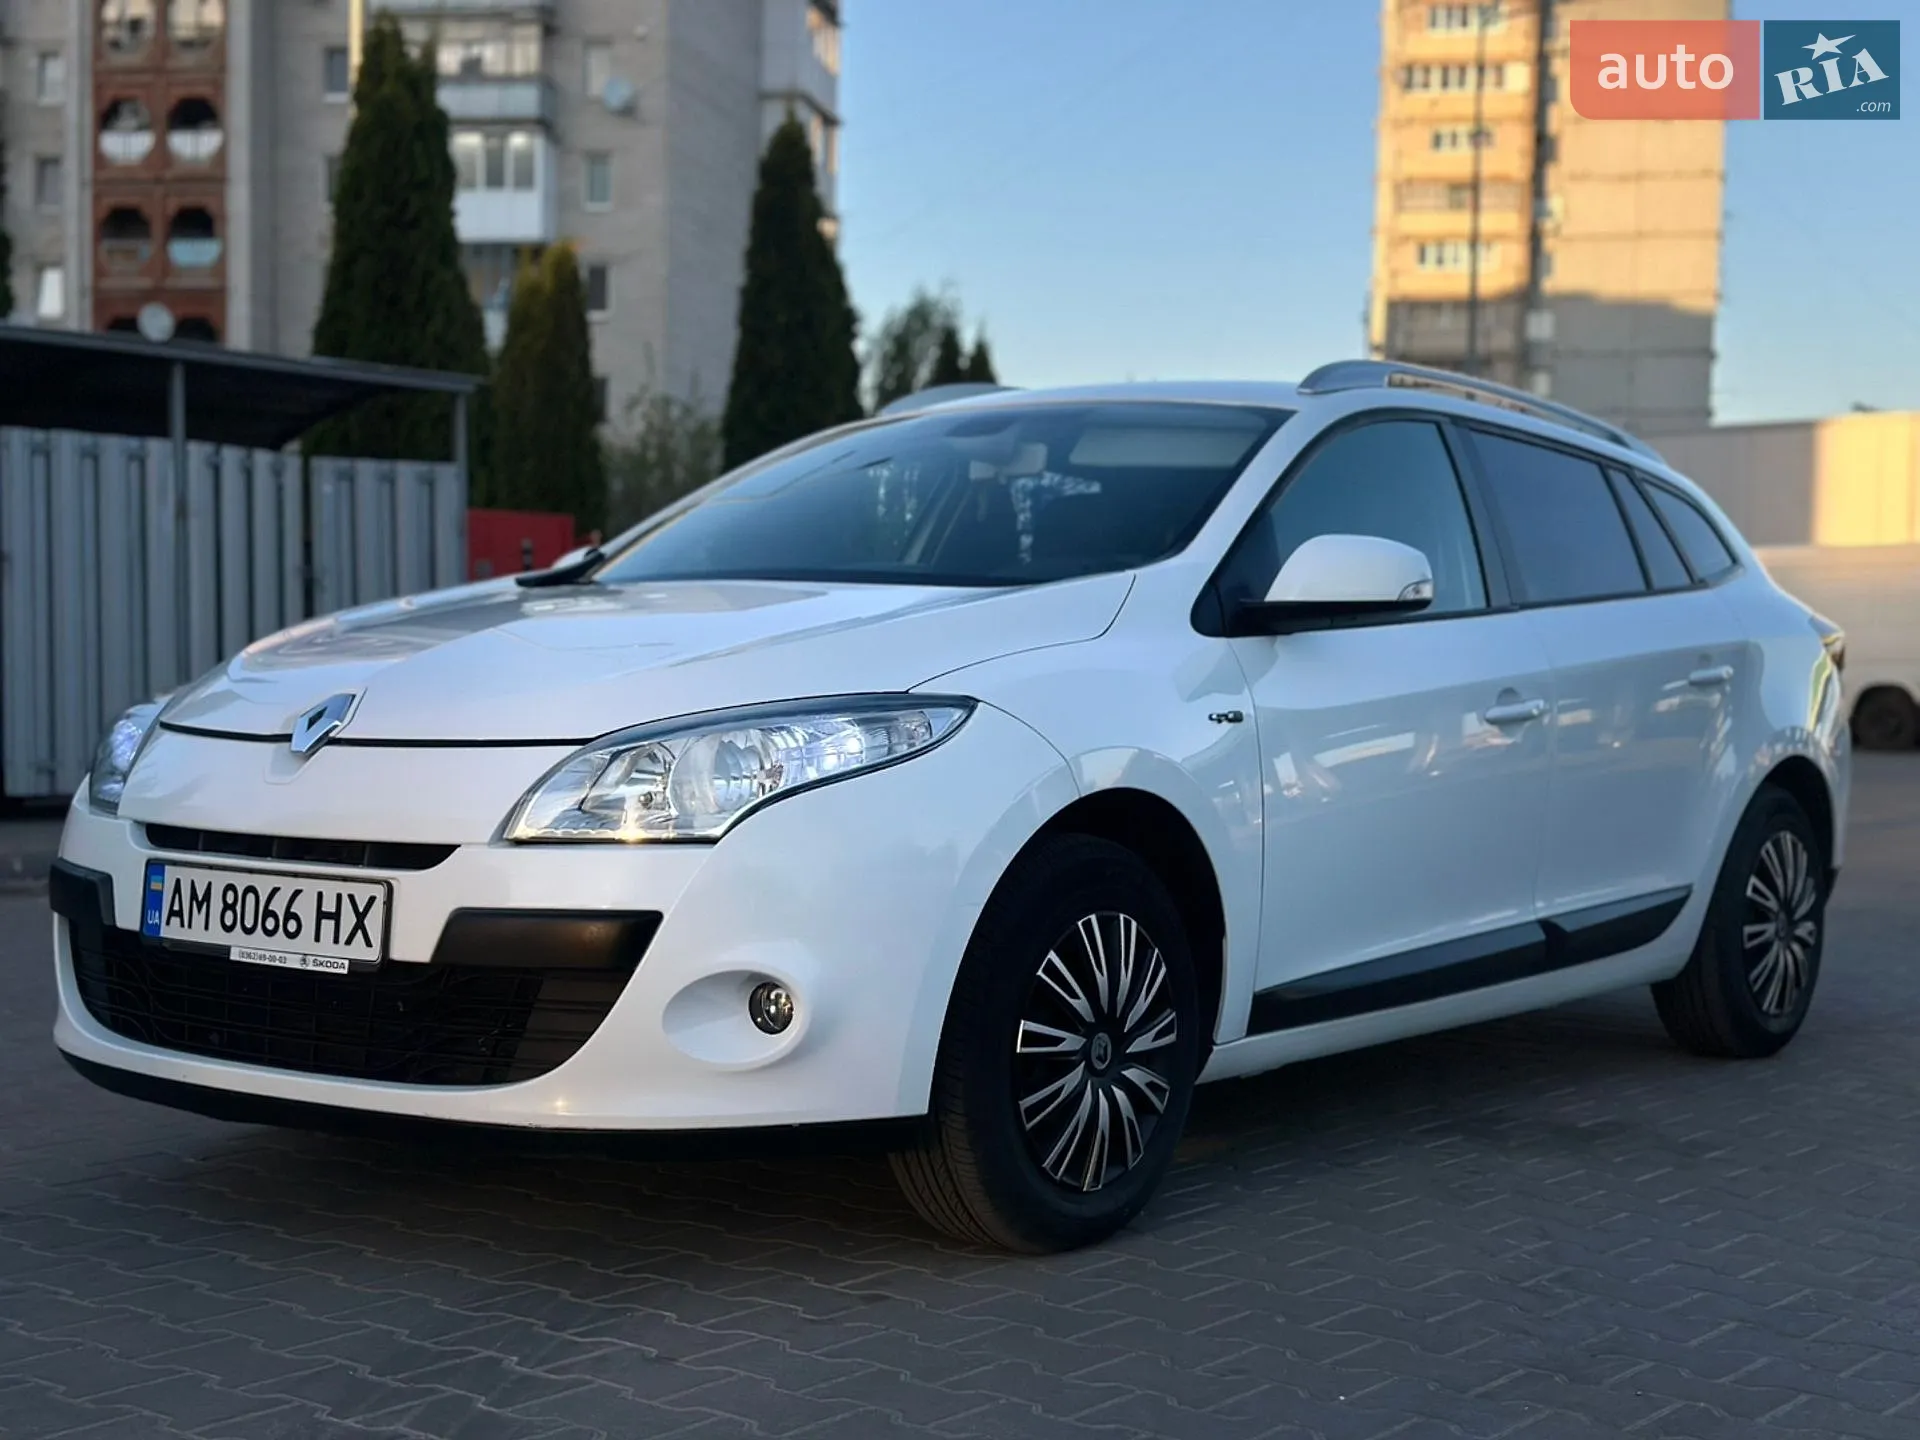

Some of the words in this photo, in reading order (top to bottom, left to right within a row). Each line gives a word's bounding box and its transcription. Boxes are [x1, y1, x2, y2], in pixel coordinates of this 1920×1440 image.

[147, 910, 160, 925] UA
[165, 877, 212, 931] AM
[219, 882, 304, 940] 8066
[313, 890, 378, 949] HX
